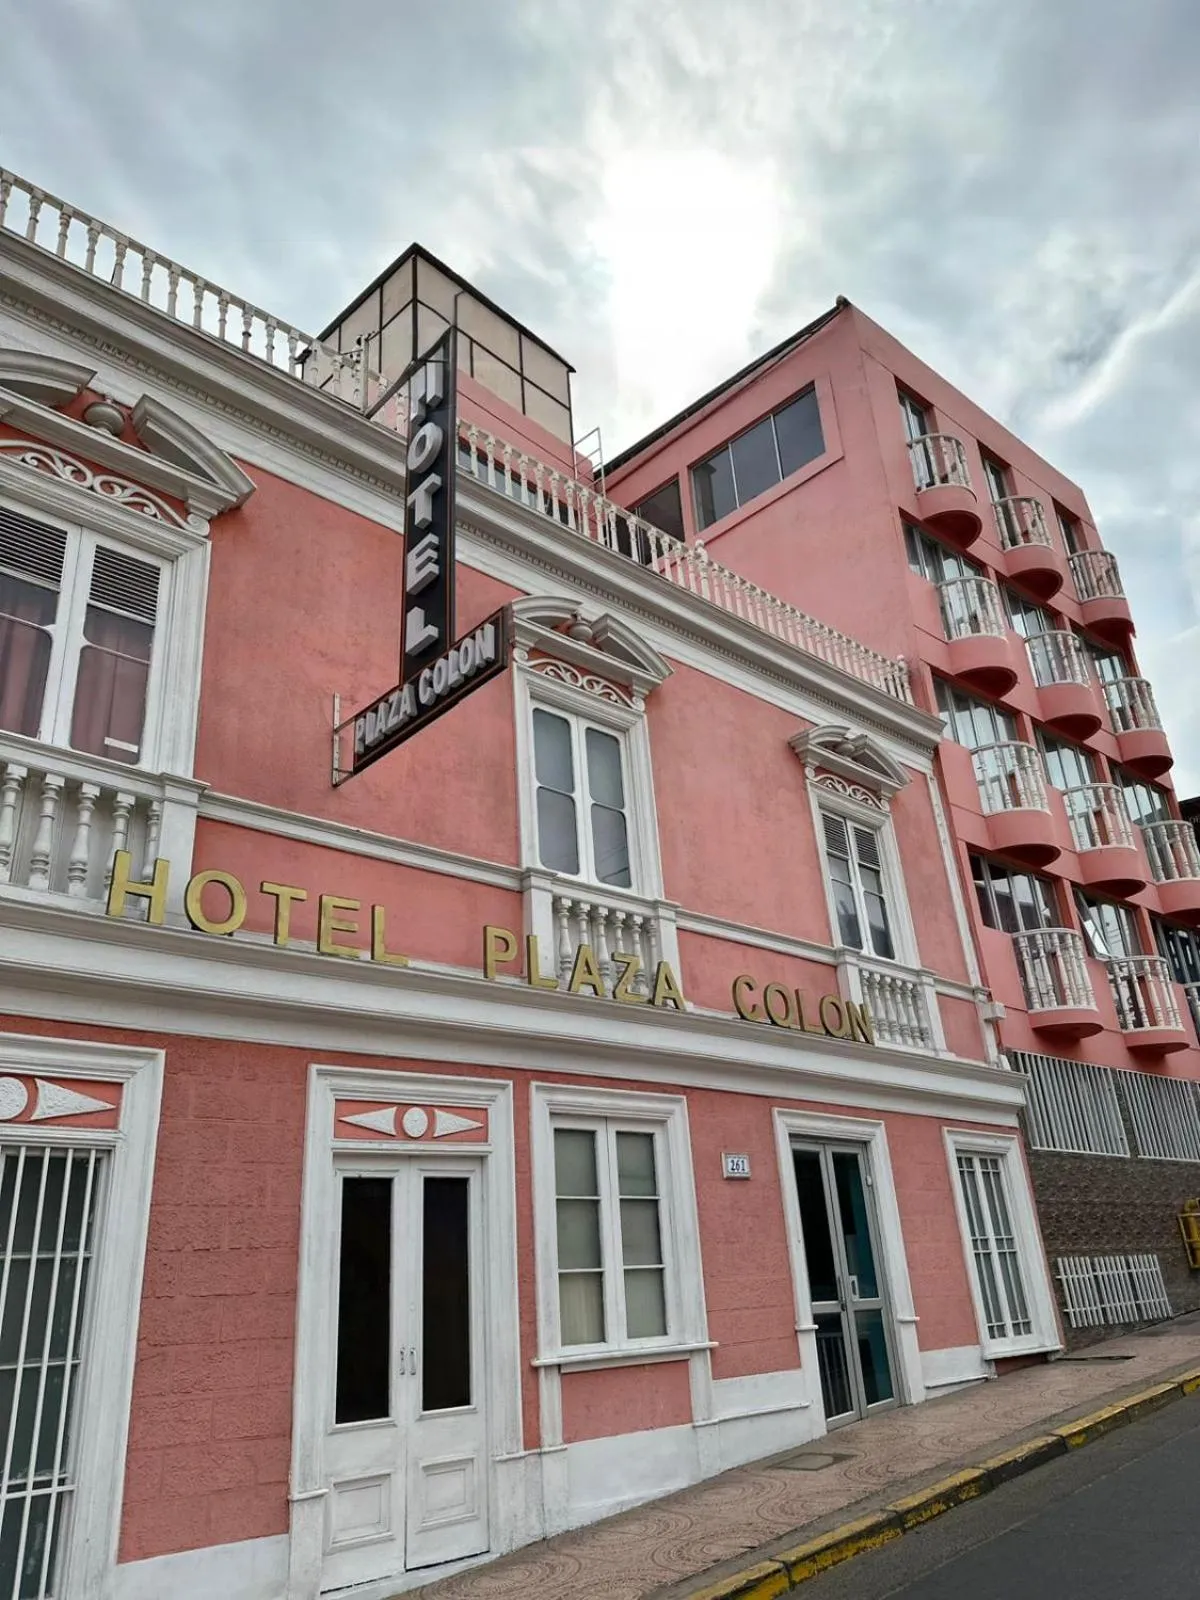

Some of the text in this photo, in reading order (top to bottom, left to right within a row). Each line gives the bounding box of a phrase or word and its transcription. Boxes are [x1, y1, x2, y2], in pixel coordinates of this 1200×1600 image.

[406, 348, 444, 656] HOTEL
[355, 623, 495, 754] PLAZA COLON
[106, 849, 875, 1045] HOTEL PLAZA COLON
